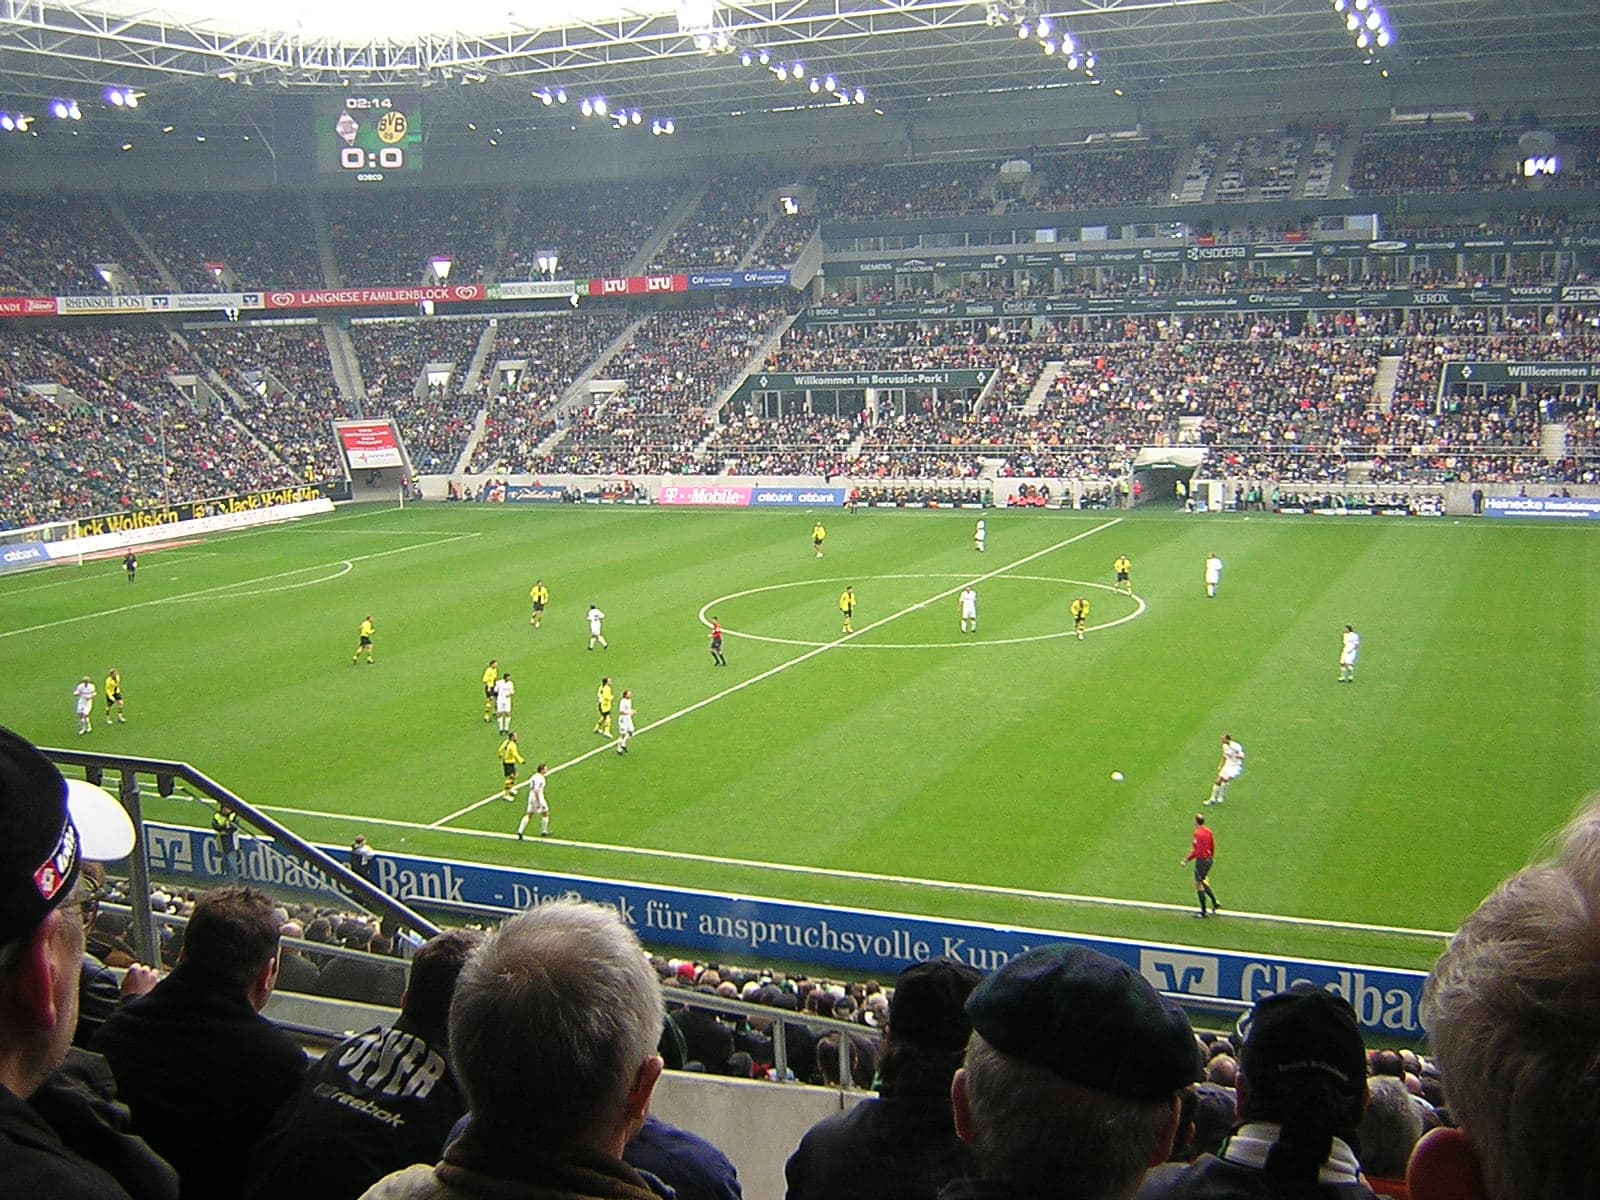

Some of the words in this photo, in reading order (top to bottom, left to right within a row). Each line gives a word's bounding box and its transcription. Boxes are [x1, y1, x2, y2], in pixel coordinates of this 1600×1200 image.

[346, 98, 392, 108] 02:14
[341, 147, 403, 168] 0:0
[1200, 246, 1246, 259] KYOCERA
[860, 263, 892, 272] SIEMENS
[604, 278, 626, 292] LTU
[649, 276, 671, 290] LTU
[301, 290, 360, 304] LANGNESE
[362, 287, 449, 302] FAMILIENBLOCK
[1510, 287, 1552, 295] VOLVO
[118, 295, 146, 307] POST
[1412, 293, 1450, 304] XEROX
[1507, 366, 1587, 377] Willkommen
[794, 375, 854, 385] Willkommen
[856, 374, 869, 384] im
[871, 372, 942, 384] Borussia-Park
[757, 492, 794, 503] citibank
[797, 492, 835, 503] citibank
[1485, 498, 1543, 510] Heinecke
[106, 509, 180, 535] Wolfskin
[376, 857, 464, 903] Bank
[645, 900, 688, 930] für
[698, 913, 931, 961] anspruchsvolle
[942, 936, 1031, 971] Kun
